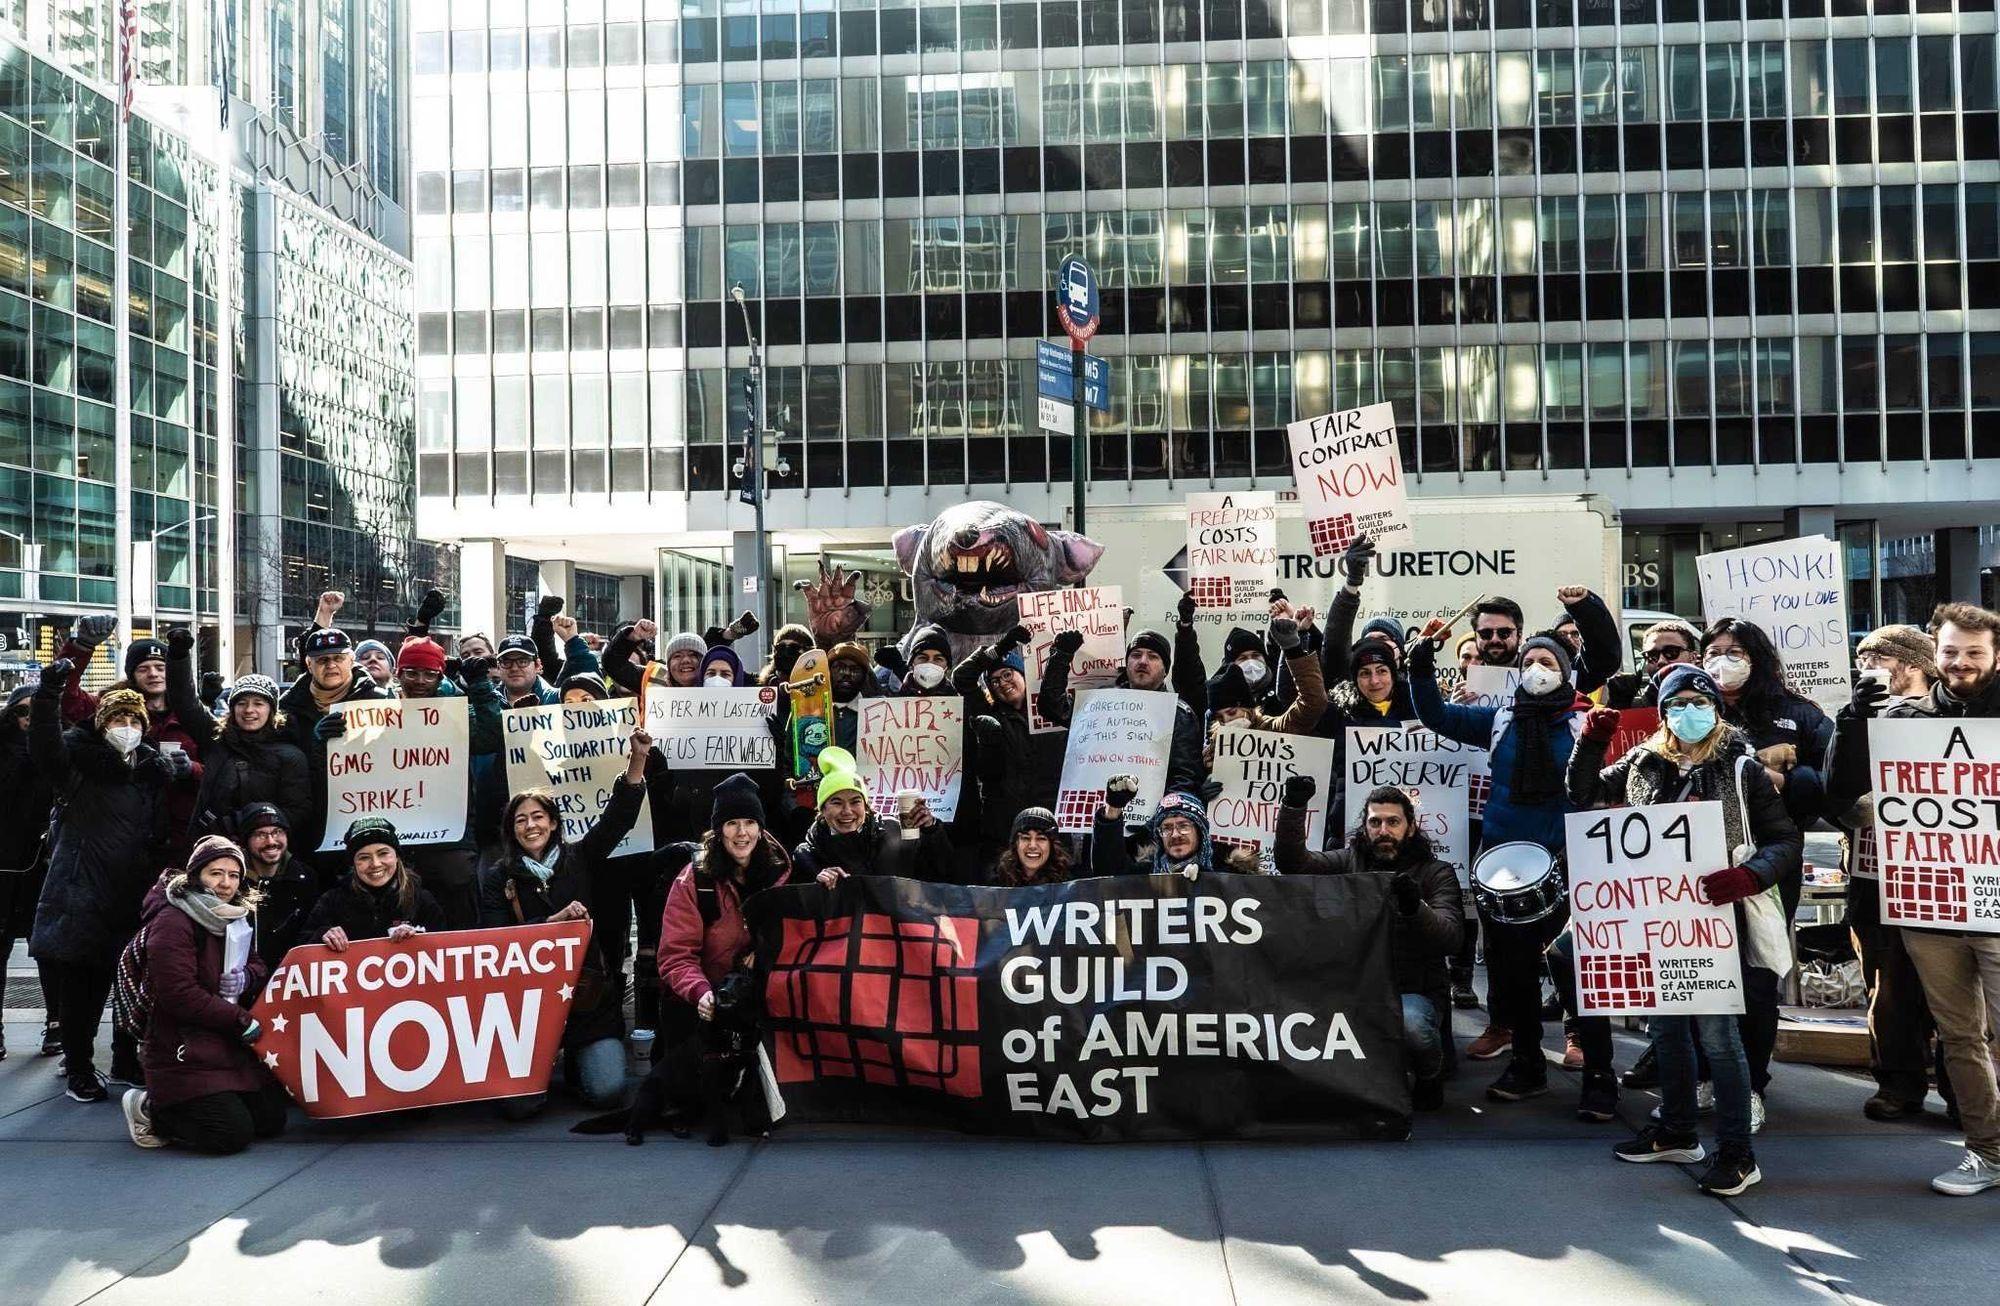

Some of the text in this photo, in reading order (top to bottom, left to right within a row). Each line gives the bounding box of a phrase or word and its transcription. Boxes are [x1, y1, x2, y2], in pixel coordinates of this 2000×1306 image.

[1069, 318, 1096, 339] STANDING
[1084, 361, 1099, 379] M5
[1084, 386, 1099, 404] M7
[1310, 410, 1362, 443] FAIR
[1299, 427, 1394, 468] CONTRACT
[1317, 456, 1397, 502] NOW
[1221, 496, 1234, 509] A
[1190, 506, 1275, 528] FREE PRESS
[1357, 510, 1393, 522] WRITERS
[1358, 520, 1384, 530] GUILD
[1200, 527, 1258, 545] COSTS
[1366, 535, 1381, 543] AST
[1370, 523, 1408, 535] AMERICA
[1191, 547, 1228, 566] FAIR
[1726, 552, 1833, 589] HONK!
[1019, 592, 1061, 618] LIFE
[1772, 594, 1799, 612] YOU
[1804, 590, 1840, 607] LOVE
[1051, 613, 1089, 635] GMG
[1226, 612, 1237, 622] to
[1411, 609, 1431, 619] our
[1772, 619, 1843, 650] IONS
[1785, 661, 1830, 671] WRITERS
[1786, 670, 1817, 679] GUILD
[1787, 677, 1847, 687] of AMERICA
[1794, 686, 1813, 695] AST
[417, 707, 439, 726] TO
[507, 706, 638, 733] CUNY STUDENTS
[649, 701, 664, 718] AS
[671, 701, 693, 718] PER
[699, 701, 718, 718] MY
[724, 701, 752, 718] LAST
[864, 699, 940, 734] FAIR
[1080, 717, 1148, 730] THE AUTHOR
[1078, 731, 1154, 744] OF THIS SIGN
[1942, 726, 1975, 759] A
[510, 736, 626, 764] IN SOLIDARITY
[677, 736, 696, 760] US
[705, 736, 736, 763] FAIR
[860, 735, 951, 765] WAGES
[1075, 753, 1085, 765] IS
[1088, 754, 1108, 764] NOW
[1109, 753, 1124, 764] ON
[329, 747, 450, 777] GMG UNION
[1240, 758, 1299, 782] THIS
[546, 766, 592, 785] WITH
[1352, 758, 1468, 789] DESERVE
[1878, 761, 1948, 794] FREE
[338, 780, 424, 813] STRIKE!
[1247, 780, 1285, 804] FO
[1585, 812, 1692, 863] 404
[1885, 831, 1956, 863] FAIR
[1573, 874, 1713, 912] CONTRAC
[1974, 898, 1988, 908] of
[1004, 896, 1263, 946] WRITERS
[1575, 917, 1733, 950] NOT FOUND
[265, 937, 581, 1004] FAIR CONTRACT
[1658, 958, 1714, 969] WRITERS
[1659, 969, 1699, 980] GUILD
[1000, 956, 1189, 1005] GUILD
[1661, 979, 1736, 991] of AMERICA
[1661, 991, 1695, 1002] EAST
[300, 988, 543, 1103] NOW
[1002, 1011, 1367, 1063] of AMERICA
[1005, 1066, 1159, 1119] EAST
